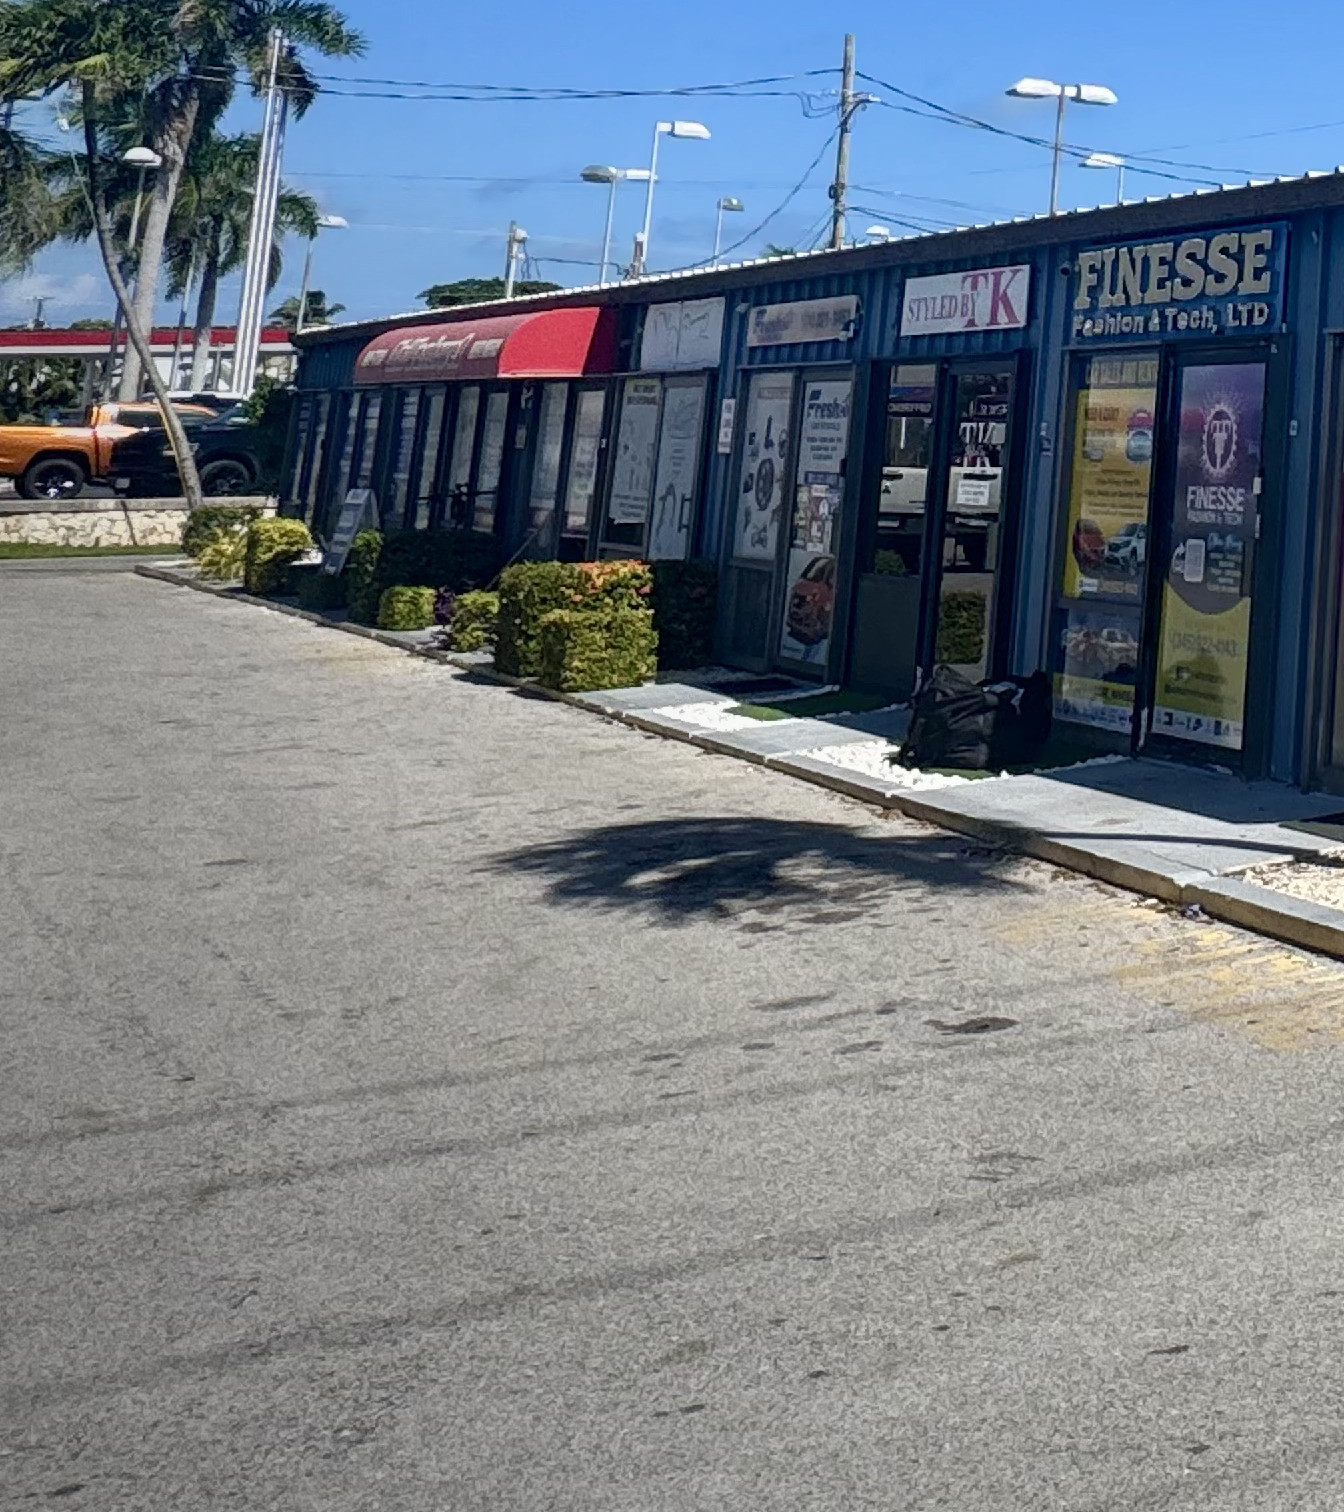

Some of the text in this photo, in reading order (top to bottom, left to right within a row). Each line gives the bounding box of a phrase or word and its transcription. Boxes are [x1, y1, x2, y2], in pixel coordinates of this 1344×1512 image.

[1073, 229, 1273, 309] FINESSE
[907, 268, 1024, 328] STYLED BY TK
[1073, 313, 1145, 338] Fashion
[1164, 303, 1218, 335] Tech,
[1226, 302, 1270, 328] LTD
[1186, 485, 1246, 513] FINESSE
